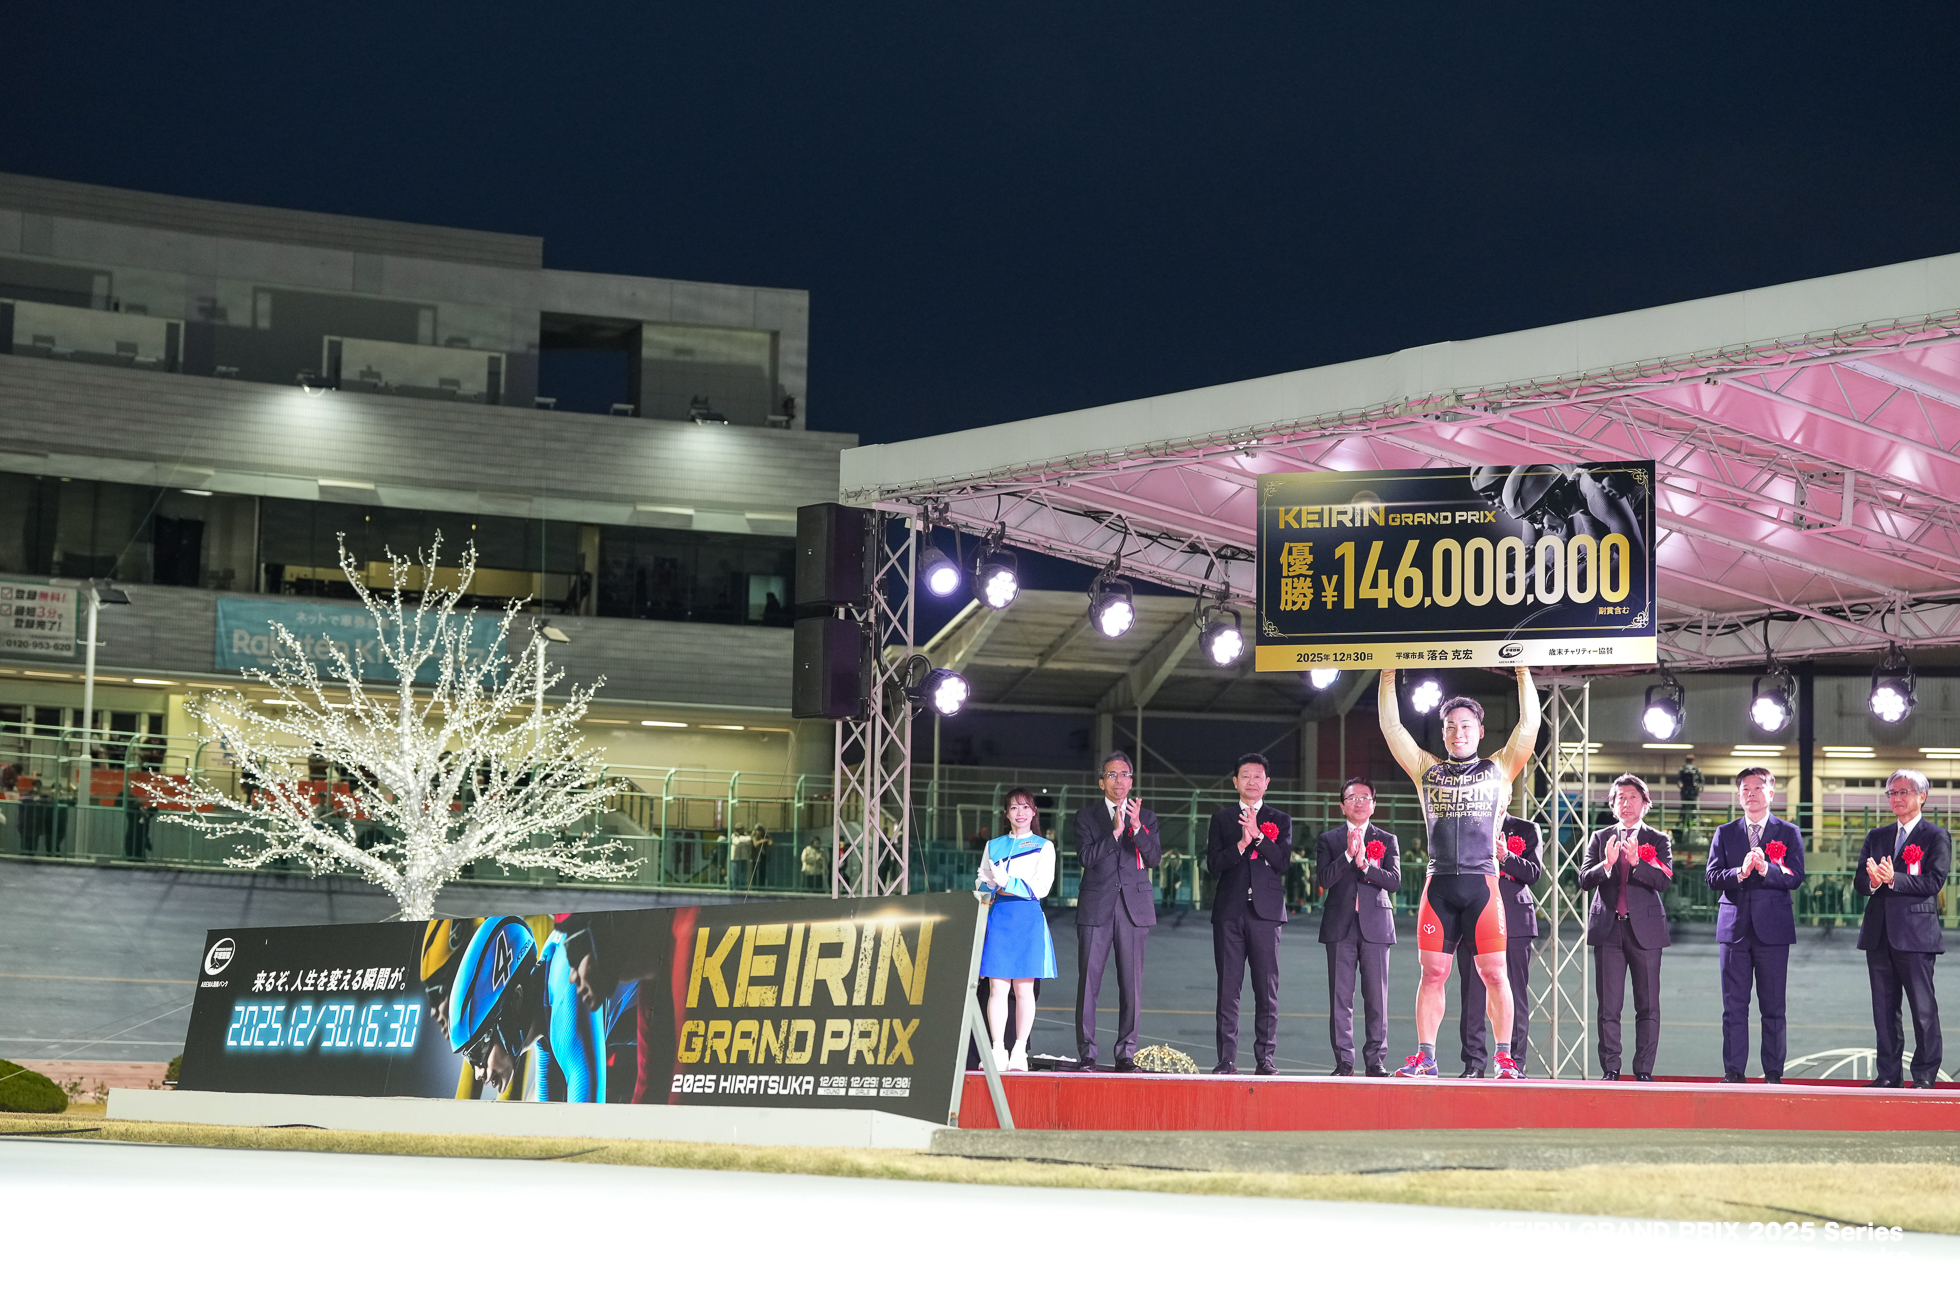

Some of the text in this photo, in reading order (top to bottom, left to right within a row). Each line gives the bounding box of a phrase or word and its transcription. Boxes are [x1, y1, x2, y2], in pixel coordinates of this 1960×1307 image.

[1278, 505, 1497, 529] KEIRIN GRAND PRIX
[1279, 541, 1314, 611] 優勝
[1321, 533, 1630, 609] ¥146,000,000
[1427, 767, 1494, 786] CHAMPION
[1427, 788, 1494, 802] KEIRIN
[1427, 802, 1493, 812] GRAND PRIX
[492, 929, 514, 992] 4
[685, 917, 935, 1008] KEIRIN
[252, 966, 406, 993] 来るぞ、人生を変える瞬間が。
[677, 1018, 920, 1065] GRAND PRIX
[671, 1074, 815, 1096] 2025 HIRATSUKA
[819, 1075, 909, 1089] 12/28 12/29 12/30
